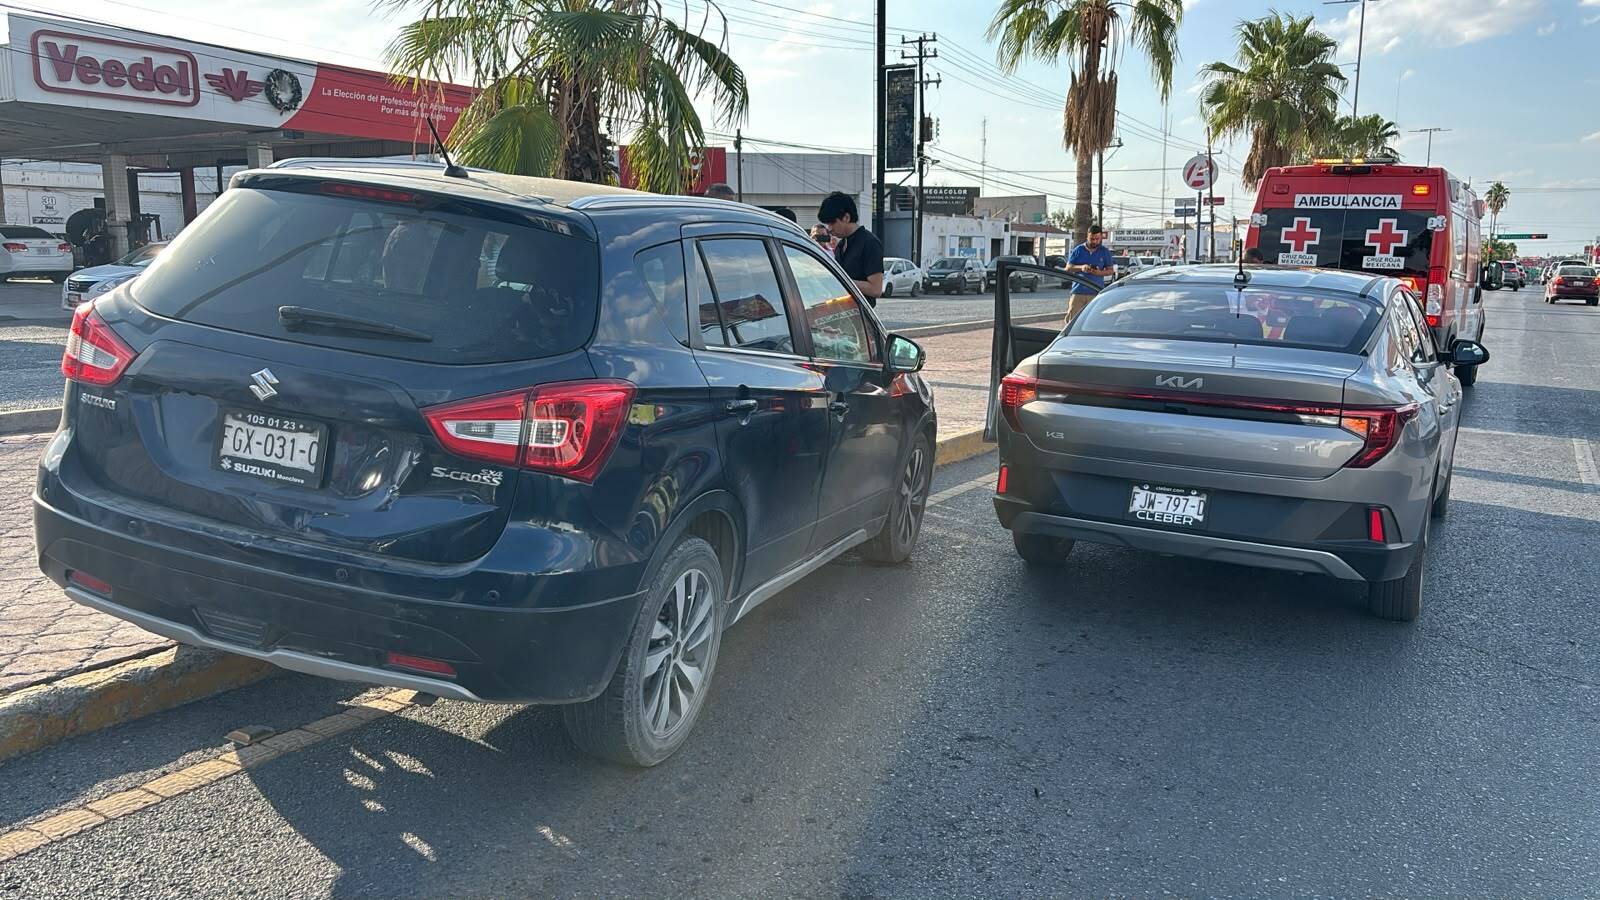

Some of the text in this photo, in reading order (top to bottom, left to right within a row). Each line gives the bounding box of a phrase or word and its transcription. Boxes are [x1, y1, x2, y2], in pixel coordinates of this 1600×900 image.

[43, 41, 191, 96] Veedol
[322, 88, 332, 96] La
[333, 88, 366, 101] Elección
[367, 94, 379, 103] del
[381, 105, 393, 114] Por
[394, 107, 409, 116] más
[411, 109, 419, 117] de
[1298, 196, 1398, 208] AMBULANCIA
[1155, 374, 1203, 389] KIA
[81, 392, 116, 410] SUZUKI
[247, 414, 296, 430] 105 01 23
[1046, 431, 1065, 439] K3
[234, 462, 305, 484] SUZUKI Monclova
[431, 466, 501, 486] S-CROSS
[480, 468, 504, 479] SX4
[1136, 510, 1194, 525] CLEBER
